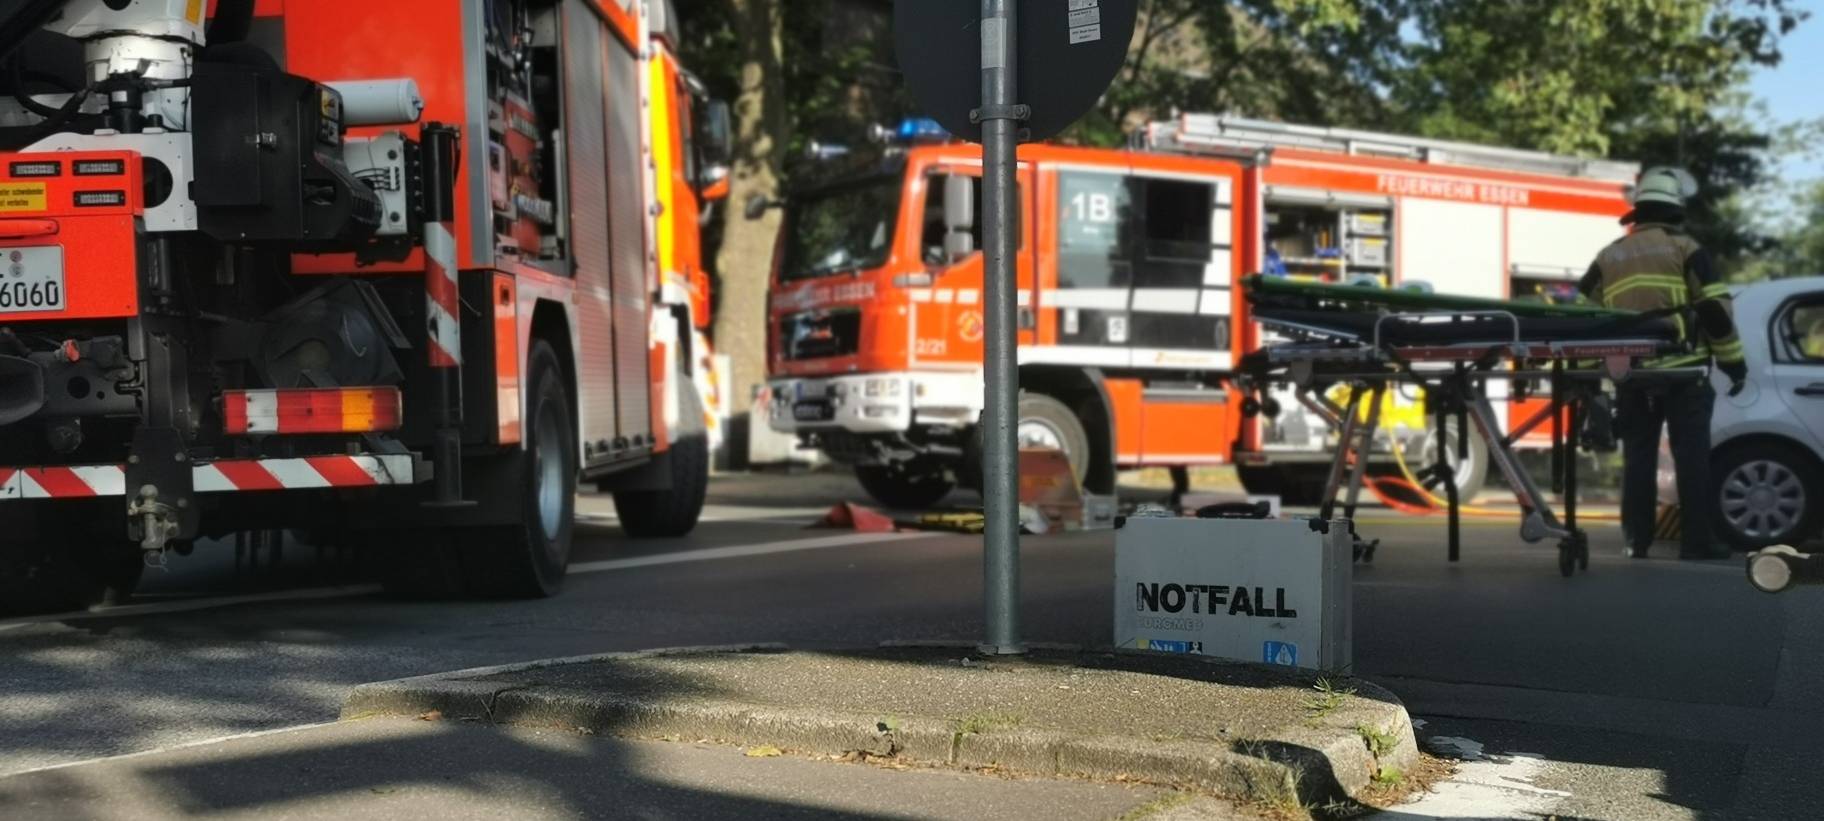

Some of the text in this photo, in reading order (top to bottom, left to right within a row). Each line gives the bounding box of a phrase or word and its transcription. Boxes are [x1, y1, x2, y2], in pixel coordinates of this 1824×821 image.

[1378, 174, 1530, 207] FEUERWEHR ESSEN
[1072, 192, 1112, 222] 1B
[0, 281, 59, 307] 6060
[1136, 582, 1298, 618] NOTFALL
